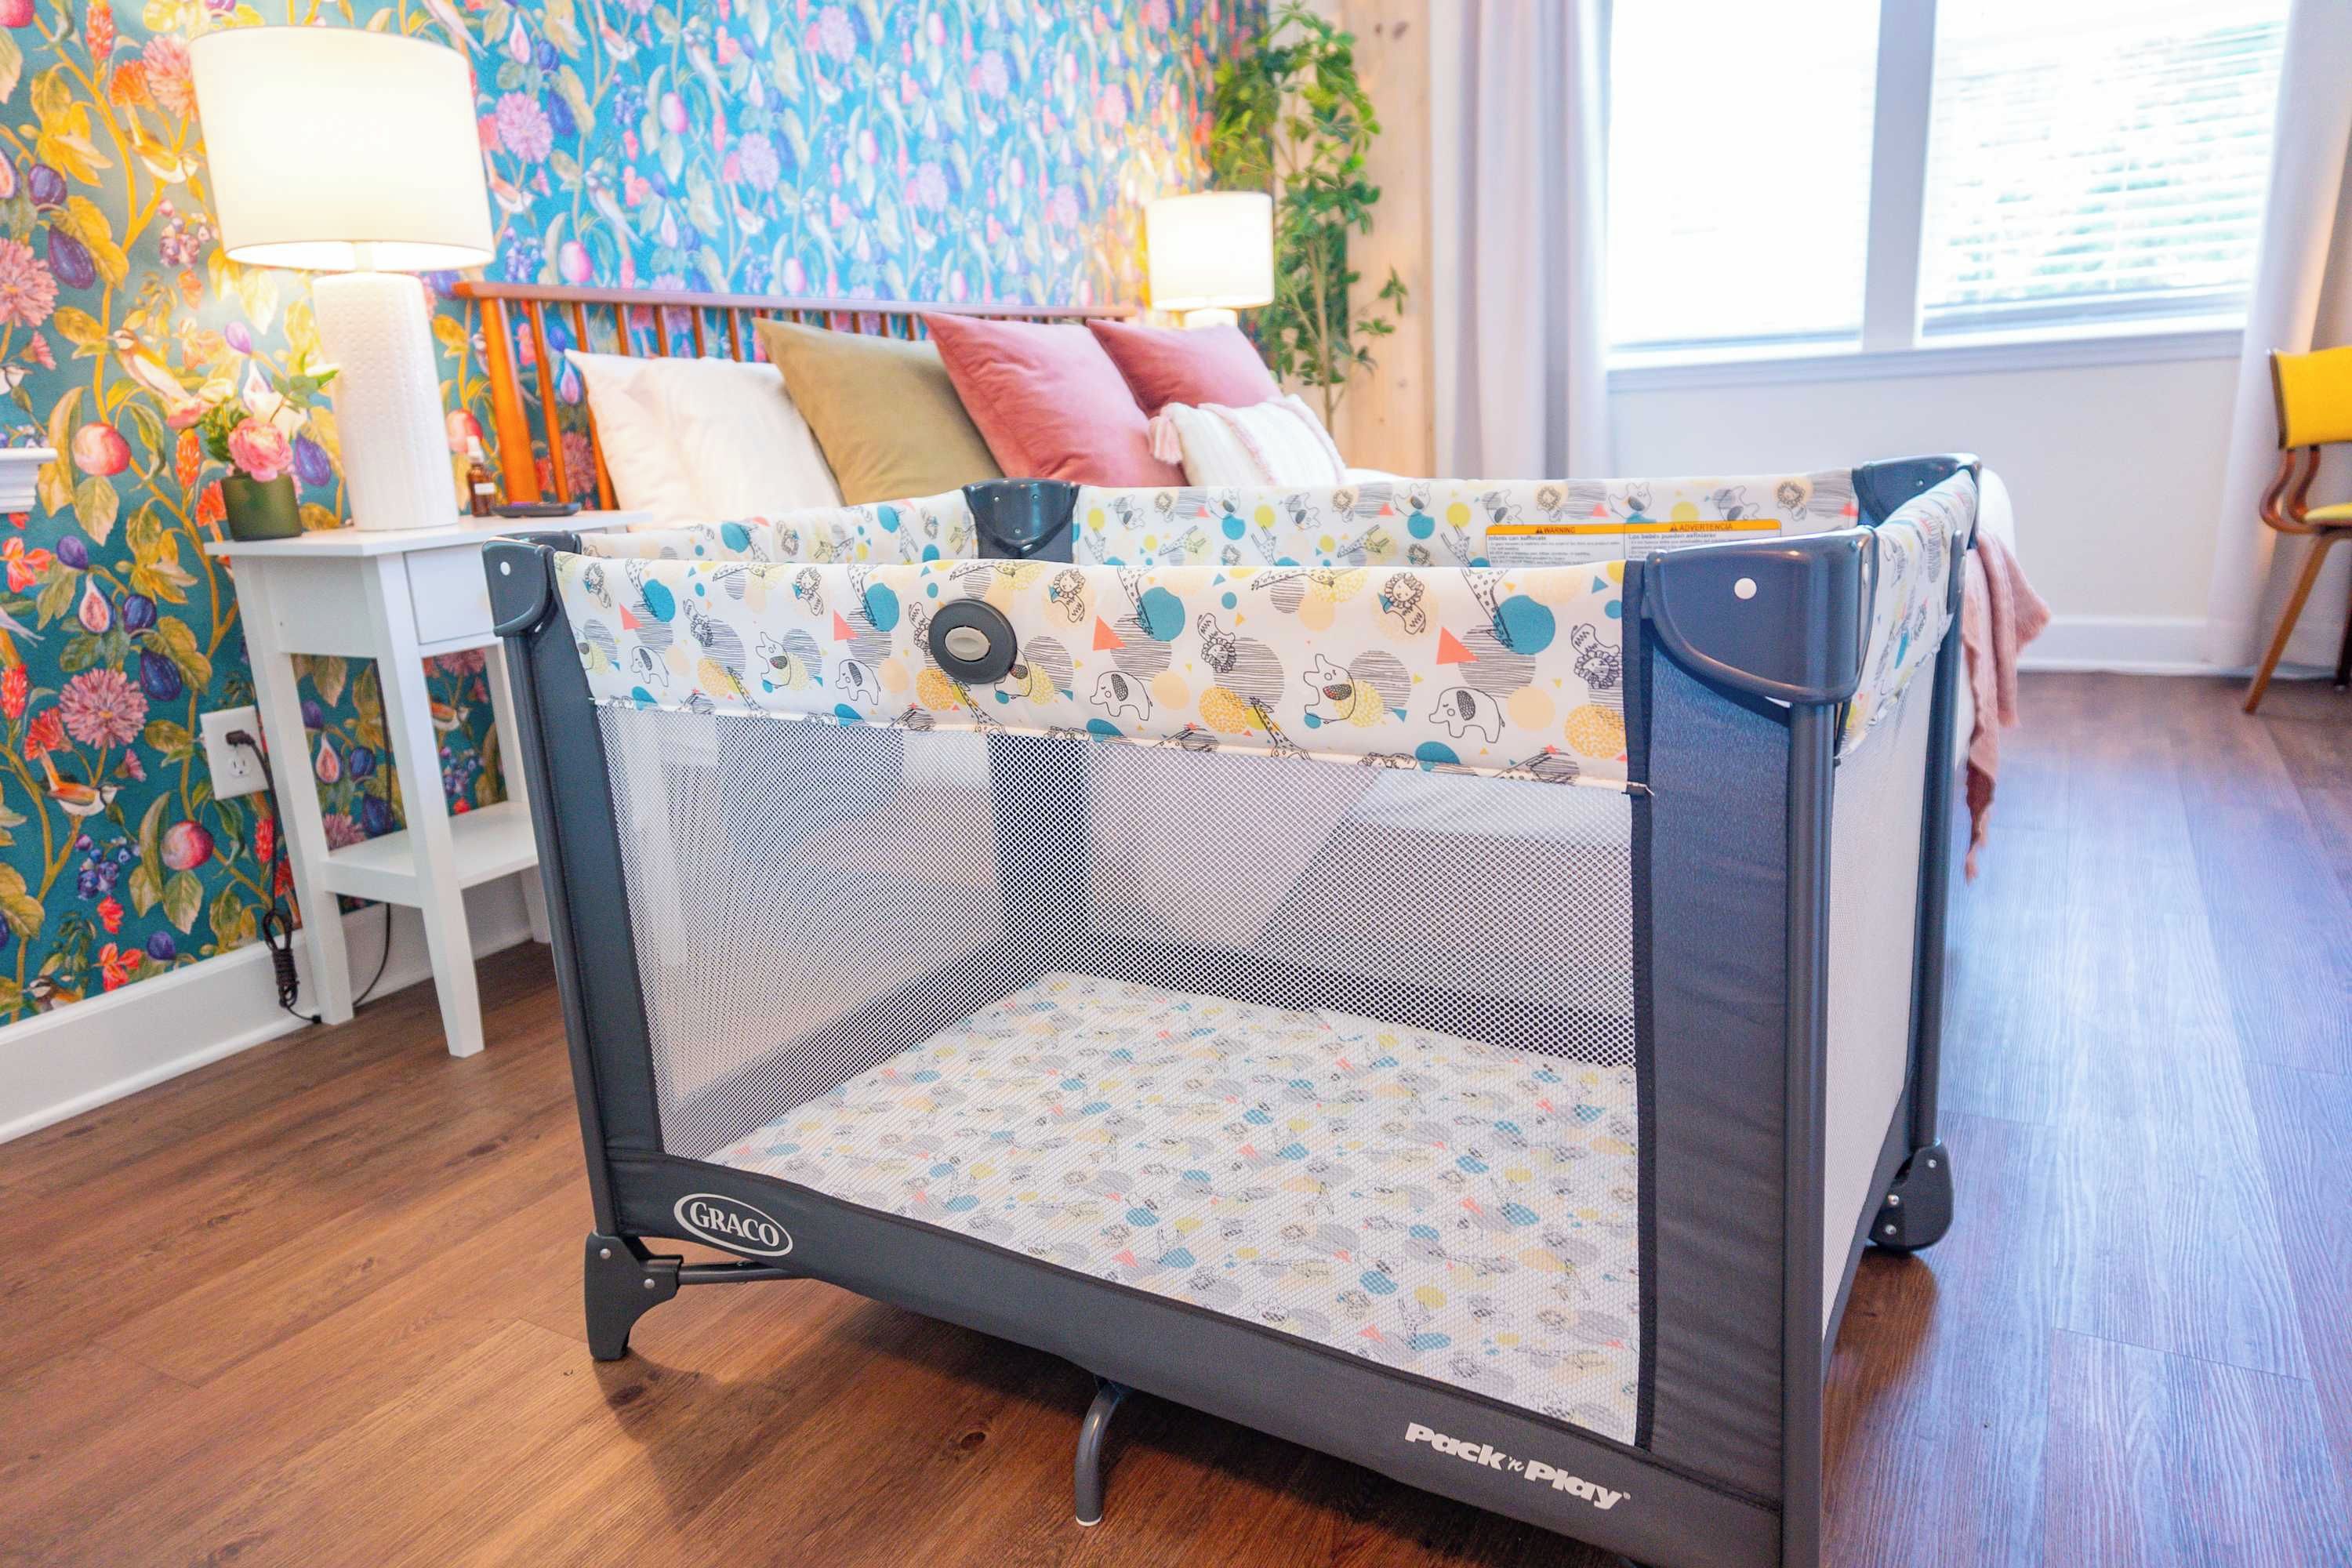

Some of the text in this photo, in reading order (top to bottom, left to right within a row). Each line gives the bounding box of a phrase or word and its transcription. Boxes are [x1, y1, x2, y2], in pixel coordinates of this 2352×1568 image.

[1679, 523, 1733, 532] ADVERTENCIA
[690, 1201, 779, 1247] GRACO
[1404, 1421, 1508, 1471] Pack
